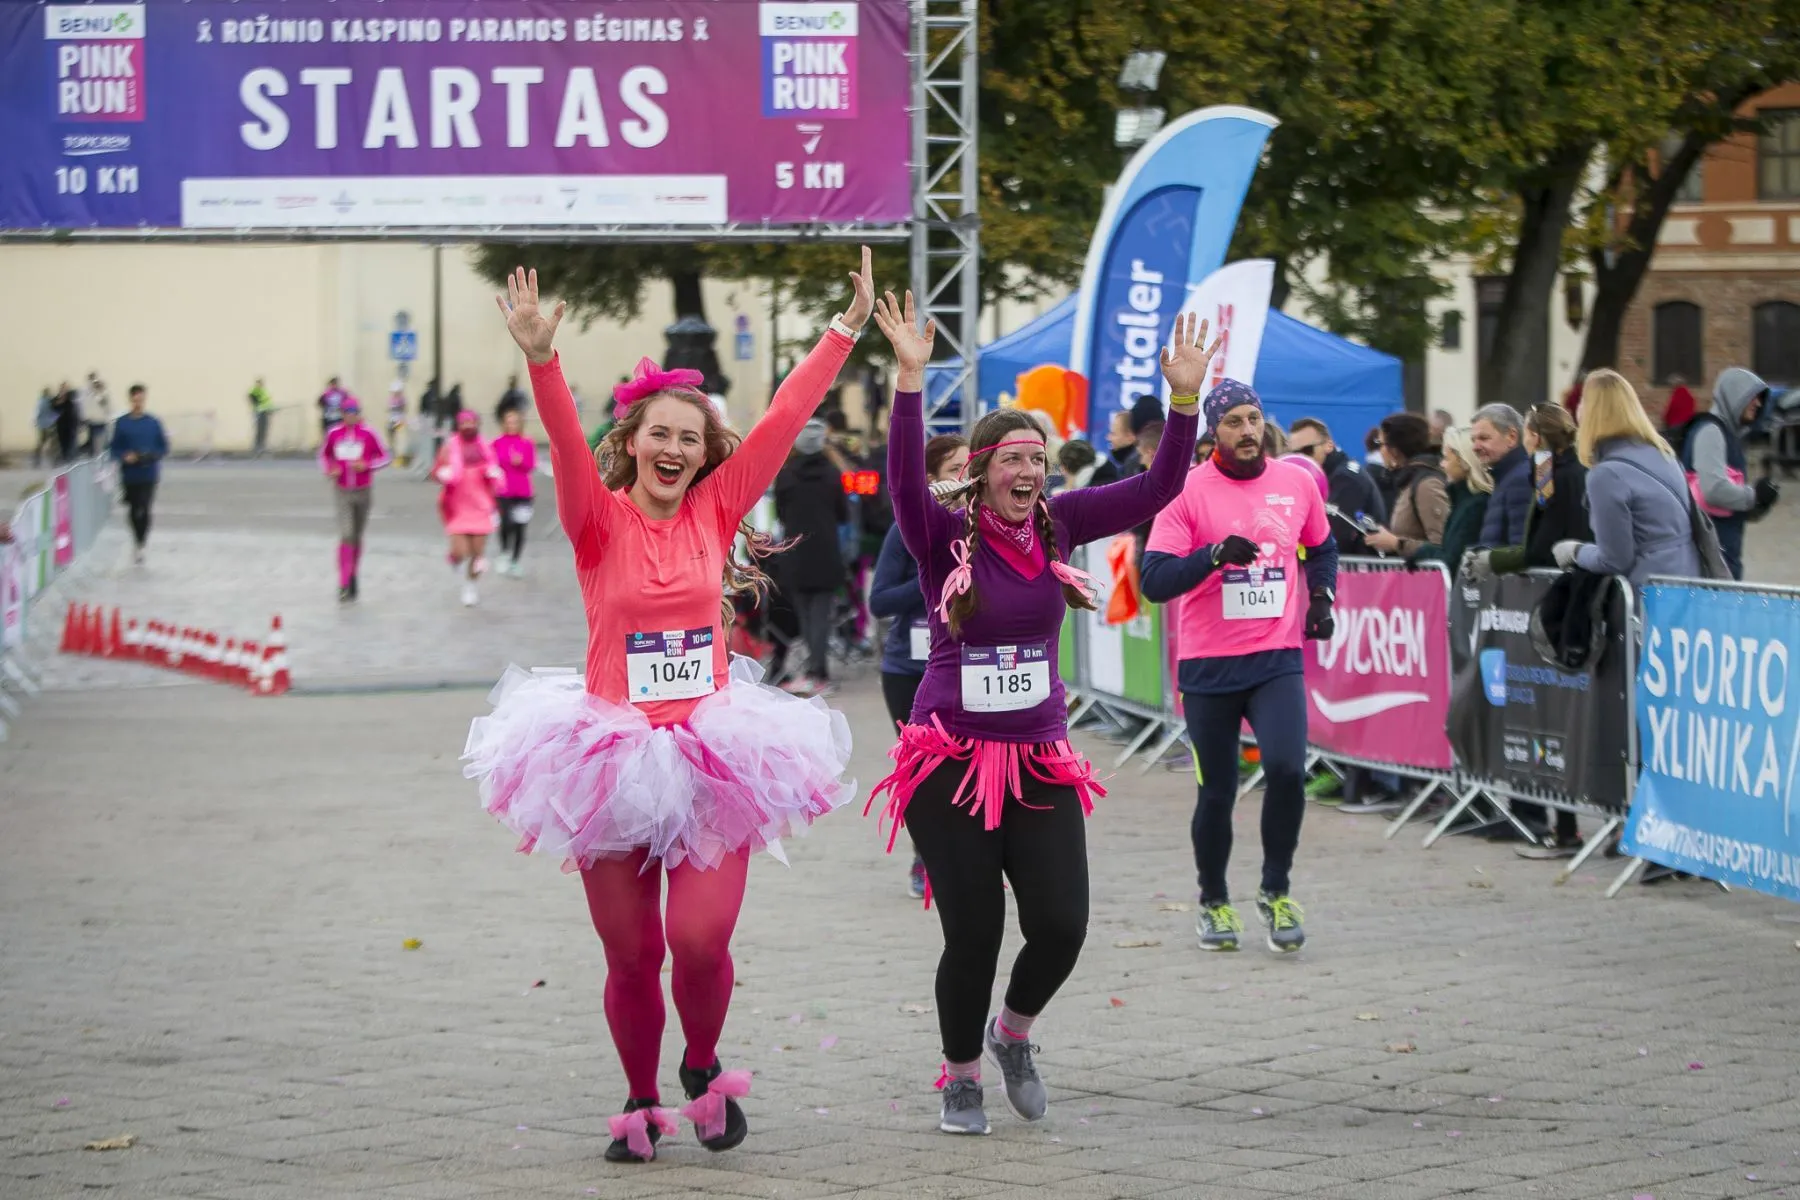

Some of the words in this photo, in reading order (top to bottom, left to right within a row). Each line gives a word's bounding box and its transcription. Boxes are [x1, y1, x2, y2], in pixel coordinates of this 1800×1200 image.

[59, 18, 112, 32] BENU
[221, 14, 324, 43] ROŽINIO
[331, 18, 442, 42] KASPINO
[449, 18, 567, 42] PARAMOS
[774, 16, 825, 30] BENU
[58, 44, 136, 78] PINK
[772, 42, 849, 75] PINK
[58, 79, 127, 114] RUN
[772, 76, 840, 110] RUN
[239, 66, 669, 150] STARTAS
[54, 166, 87, 194] 10
[96, 165, 139, 194] KM
[775, 161, 795, 189] 5
[803, 161, 845, 189] KM
[1240, 590, 1275, 606] 1041
[666, 640, 684, 648] PINK
[692, 635, 700, 645] 10
[666, 648, 682, 656] RUN
[1000, 654, 1014, 662] PINK
[1023, 649, 1030, 659] 10
[1031, 648, 1042, 657] km
[650, 660, 701, 683] 1047
[1643, 624, 1788, 717] SPORTO
[983, 673, 1032, 694] 1185
